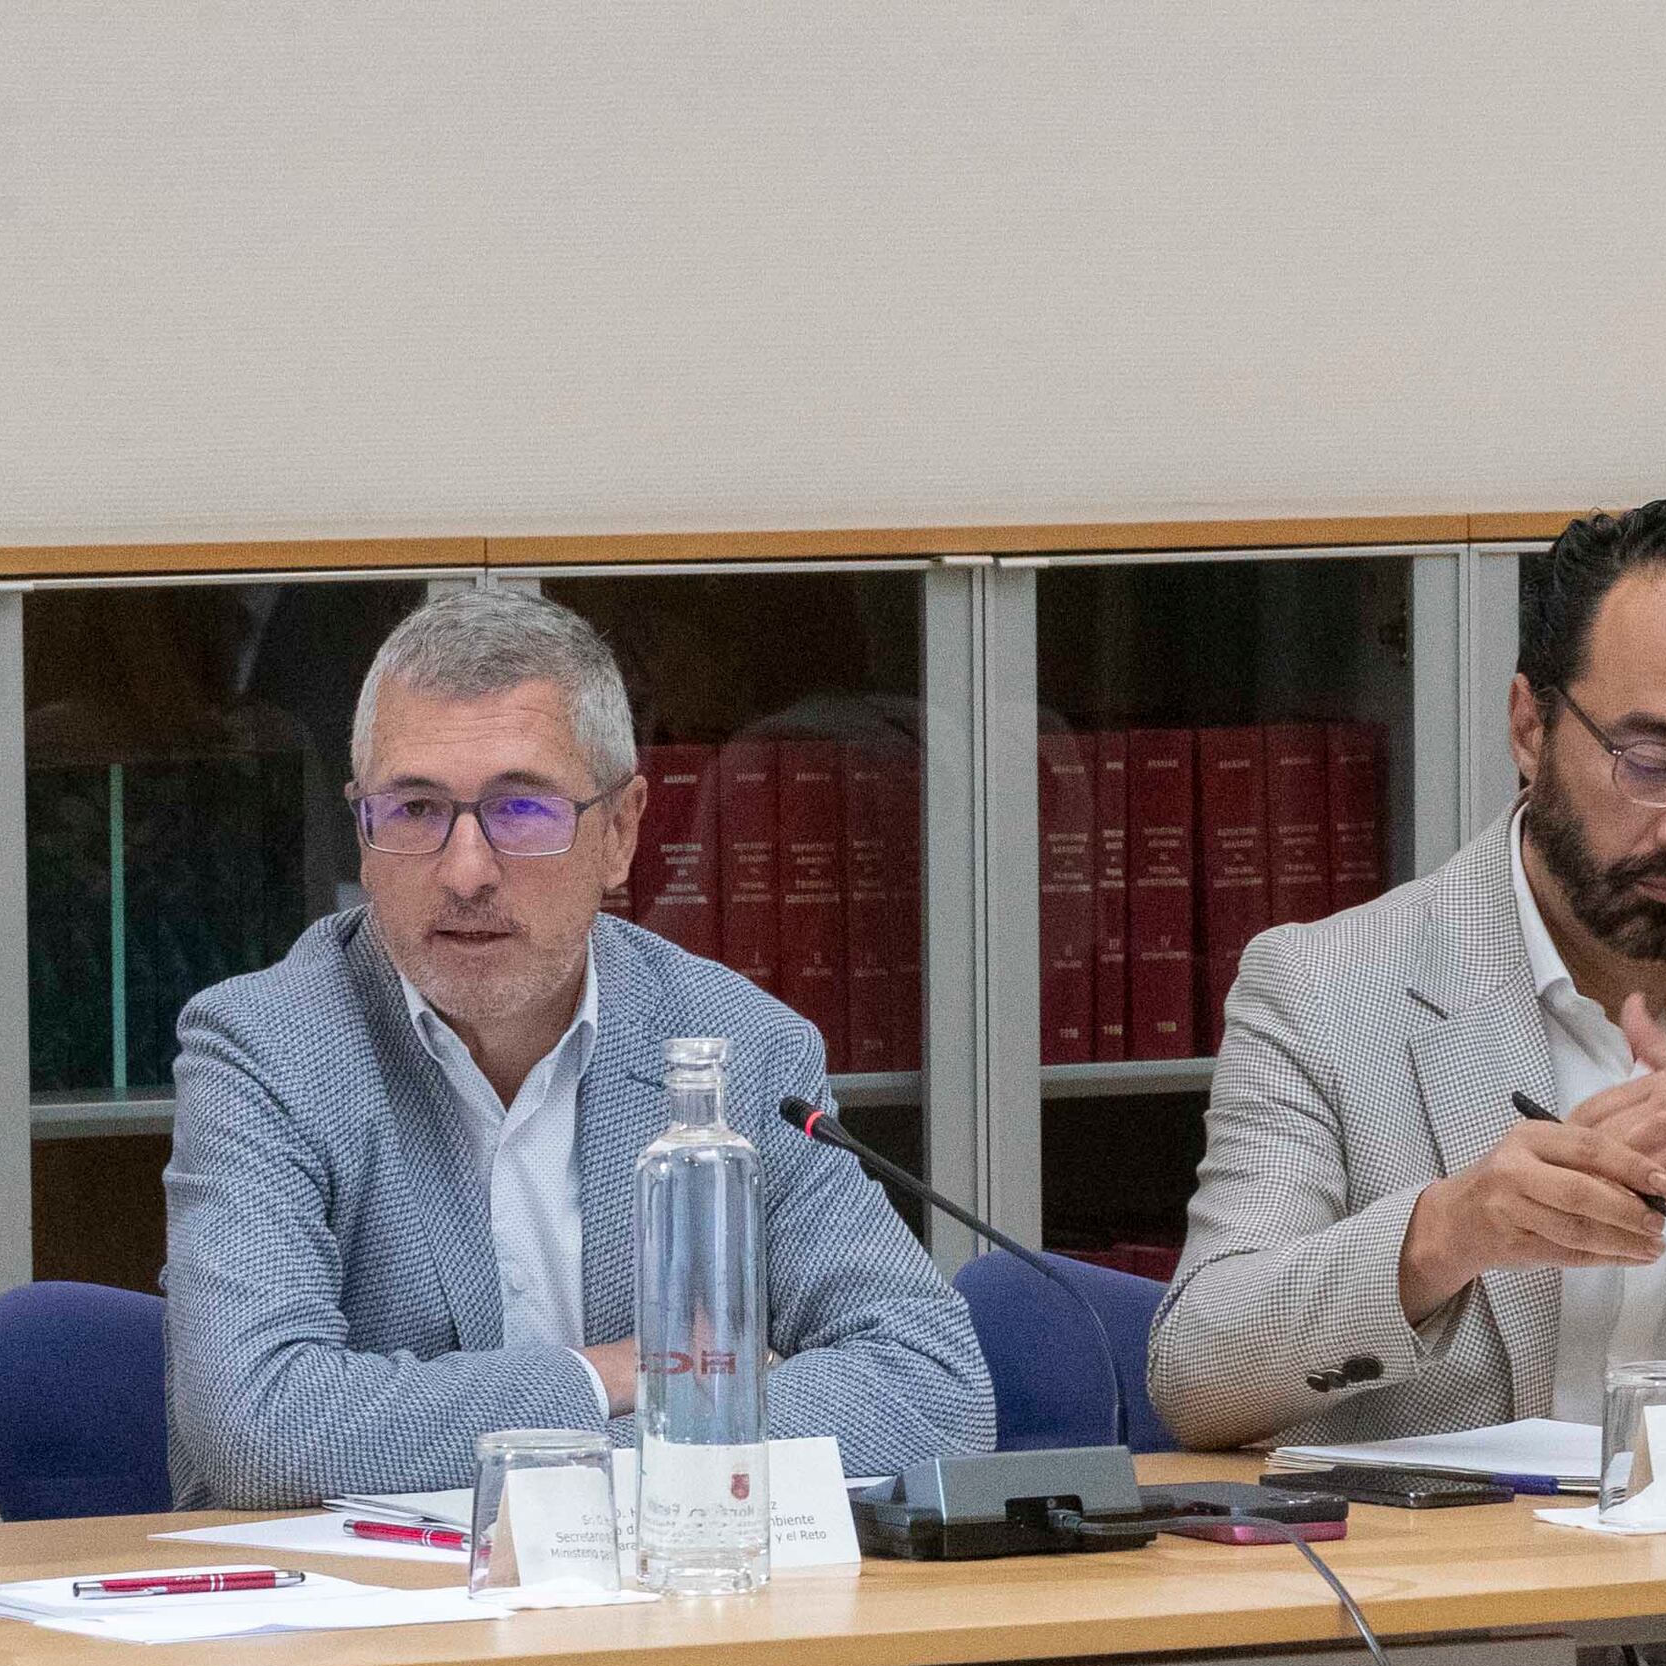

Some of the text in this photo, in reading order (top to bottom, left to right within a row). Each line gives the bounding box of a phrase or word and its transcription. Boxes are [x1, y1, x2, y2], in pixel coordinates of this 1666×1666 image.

[775, 1533, 783, 1545] y
[786, 1531, 797, 1542] el
[800, 1530, 827, 1541] Reto
